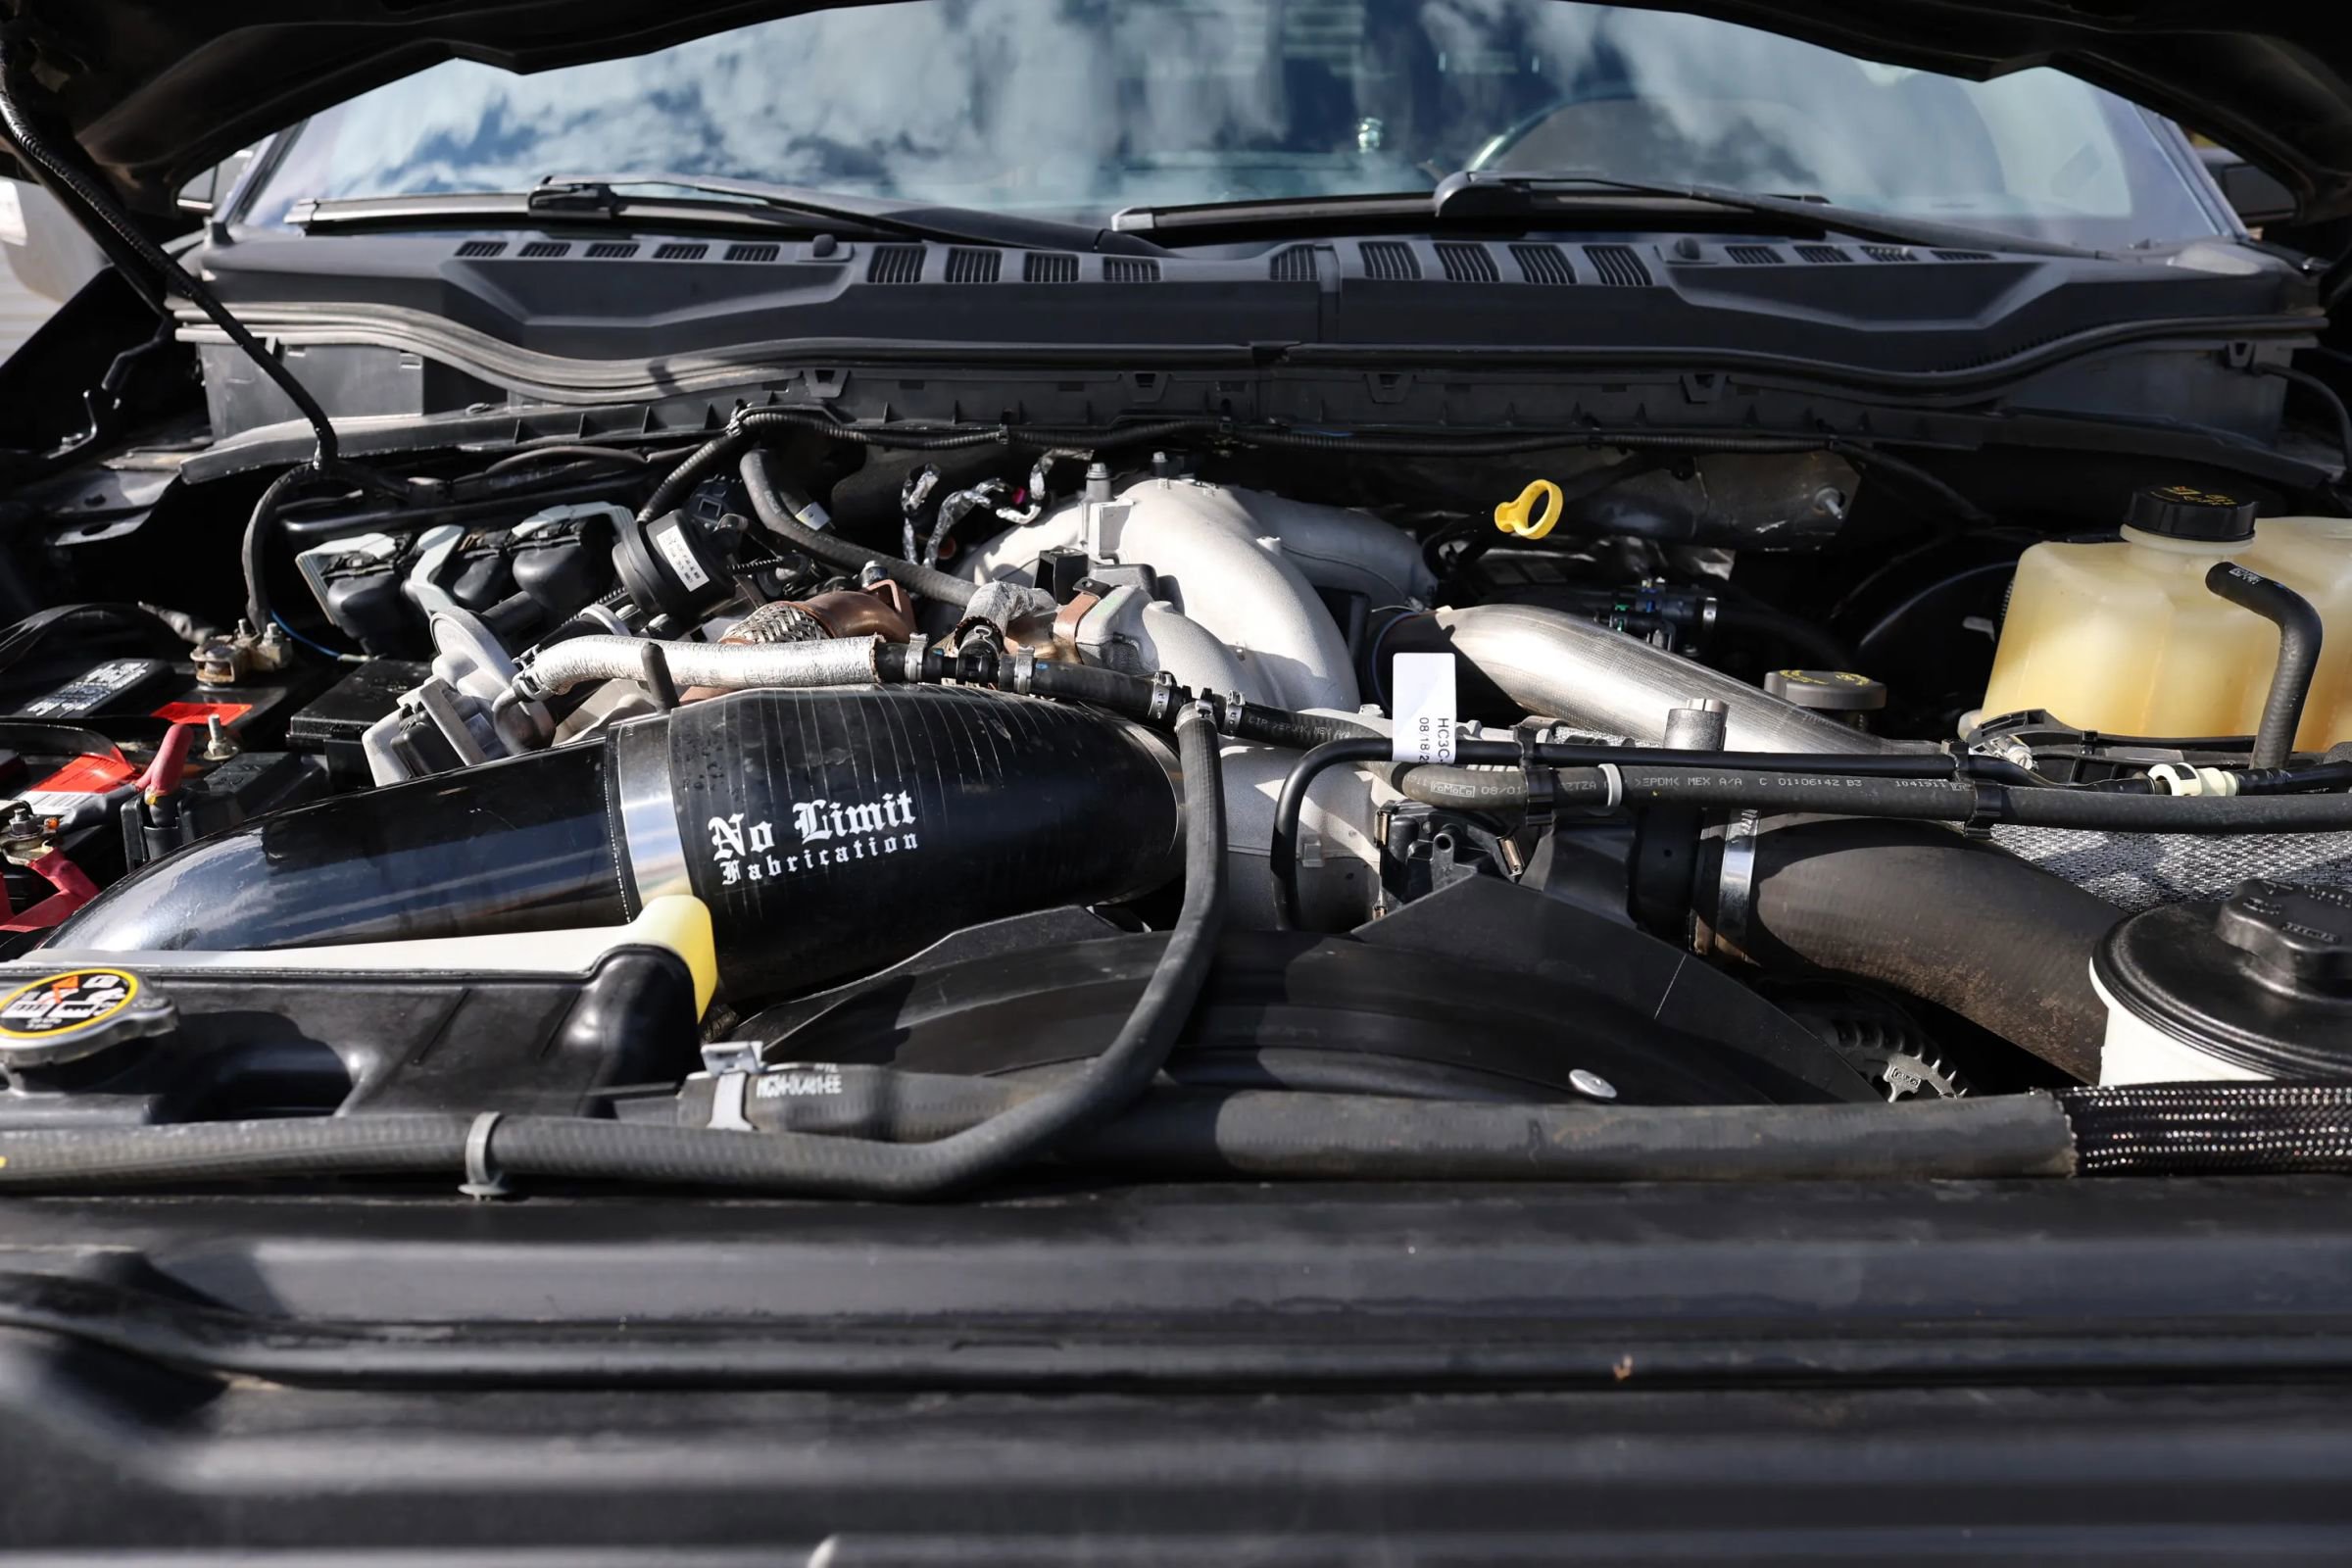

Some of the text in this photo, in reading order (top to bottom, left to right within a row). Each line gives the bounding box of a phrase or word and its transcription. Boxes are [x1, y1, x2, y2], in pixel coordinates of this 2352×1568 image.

[1419, 717, 1430, 763] 08/18/2
[1688, 777, 1711, 787] MEX
[1719, 777, 1743, 787] A/A
[1759, 777, 1768, 786] C
[708, 790, 917, 861] No Limit
[718, 832, 919, 885] Fabrication
